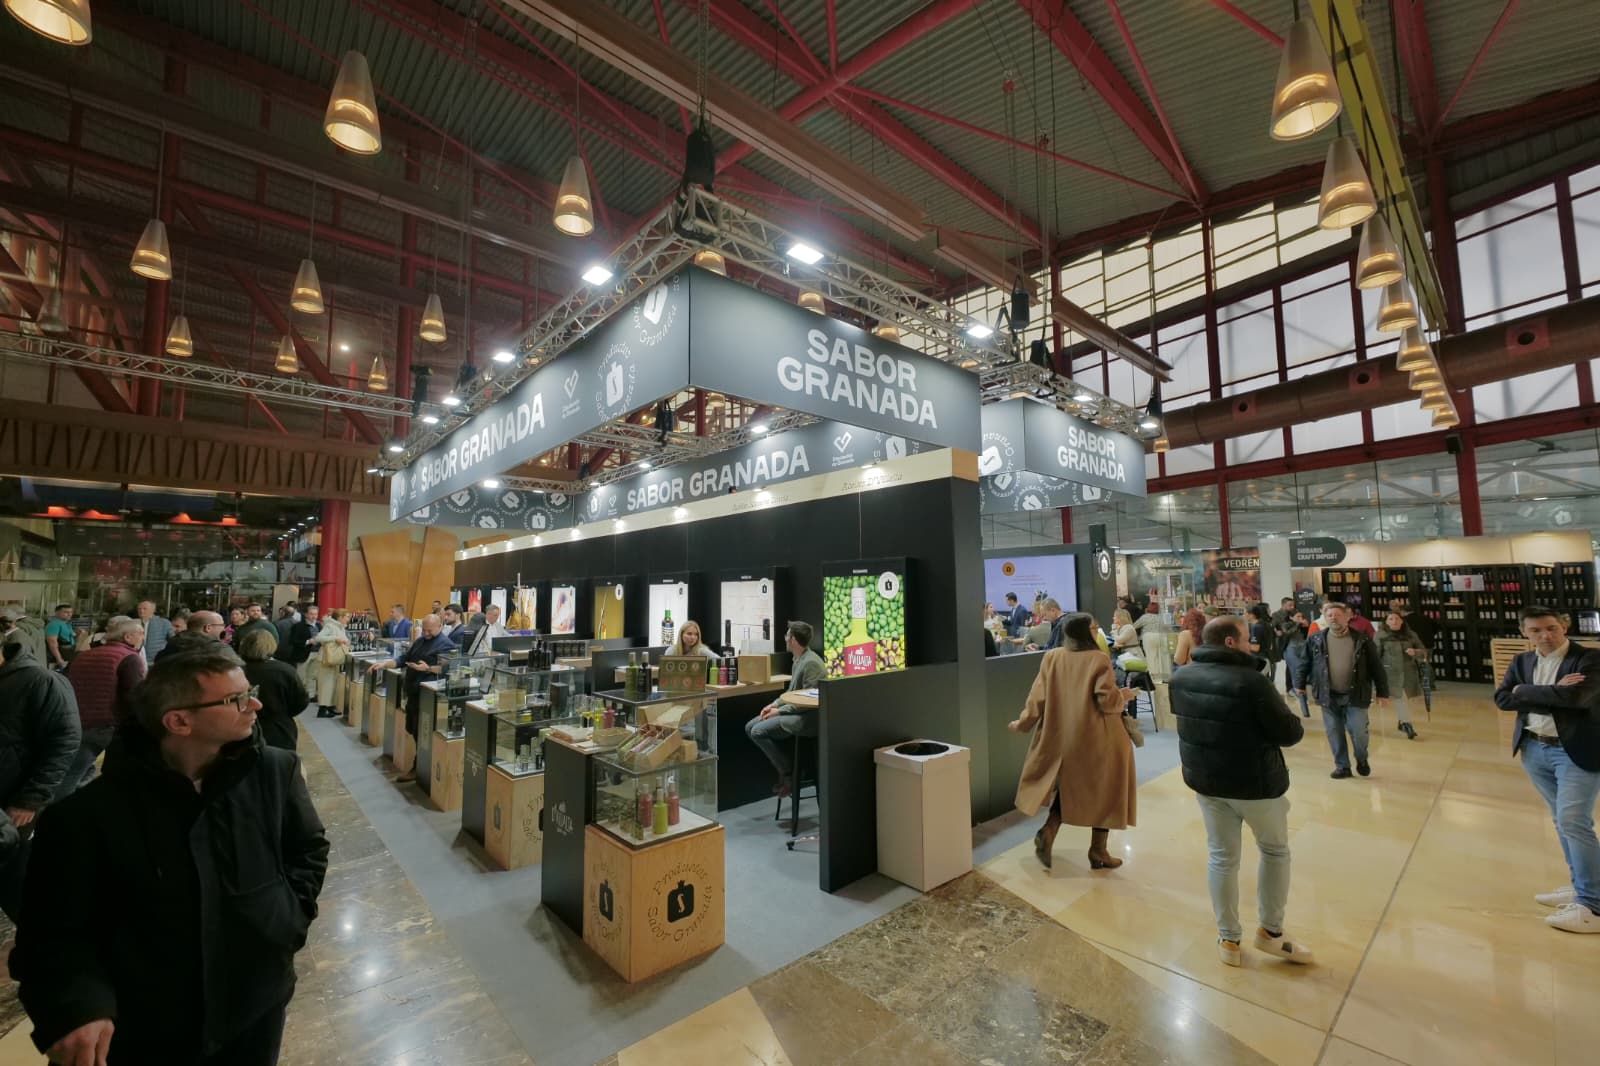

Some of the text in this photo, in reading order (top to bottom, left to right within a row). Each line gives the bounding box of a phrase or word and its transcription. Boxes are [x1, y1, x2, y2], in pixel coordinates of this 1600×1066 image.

[777, 356, 938, 429] GRANADA
[807, 328, 917, 392] SABOR
[421, 392, 545, 492] SABOR GRANADA
[1057, 445, 1126, 483] GRANADA
[1068, 425, 1115, 459] SABOR
[627, 477, 684, 511] SABOR
[689, 444, 810, 497] GRANADA
